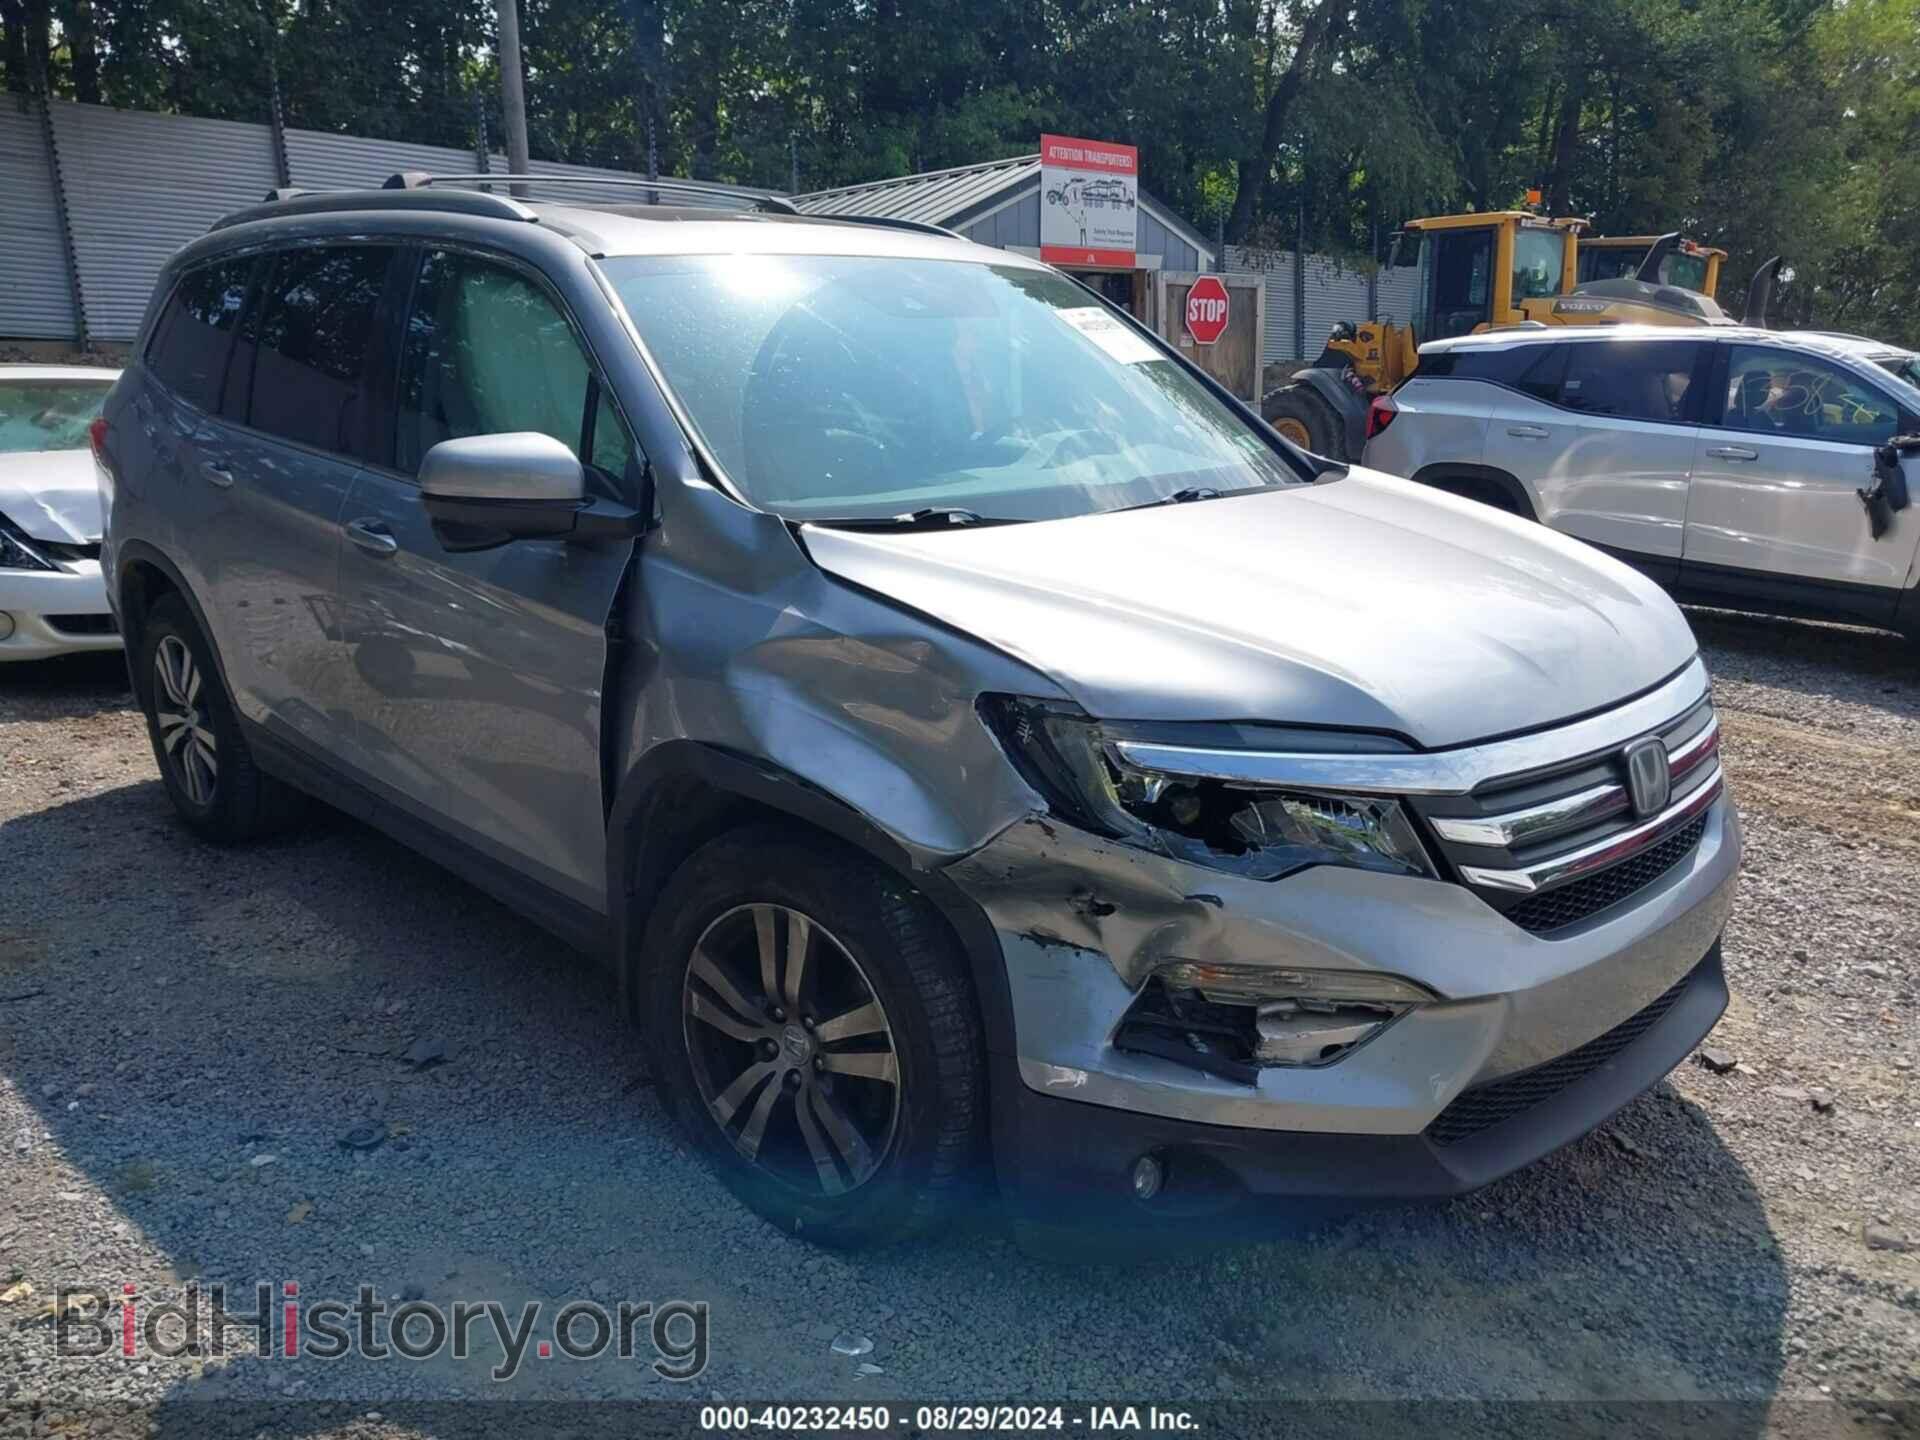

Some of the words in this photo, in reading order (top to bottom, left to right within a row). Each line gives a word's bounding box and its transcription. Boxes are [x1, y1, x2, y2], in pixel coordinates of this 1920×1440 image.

[1049, 146, 1083, 161] ATTENTION
[1189, 298, 1226, 322] STOP
[1560, 303, 1605, 311] VOLVO
